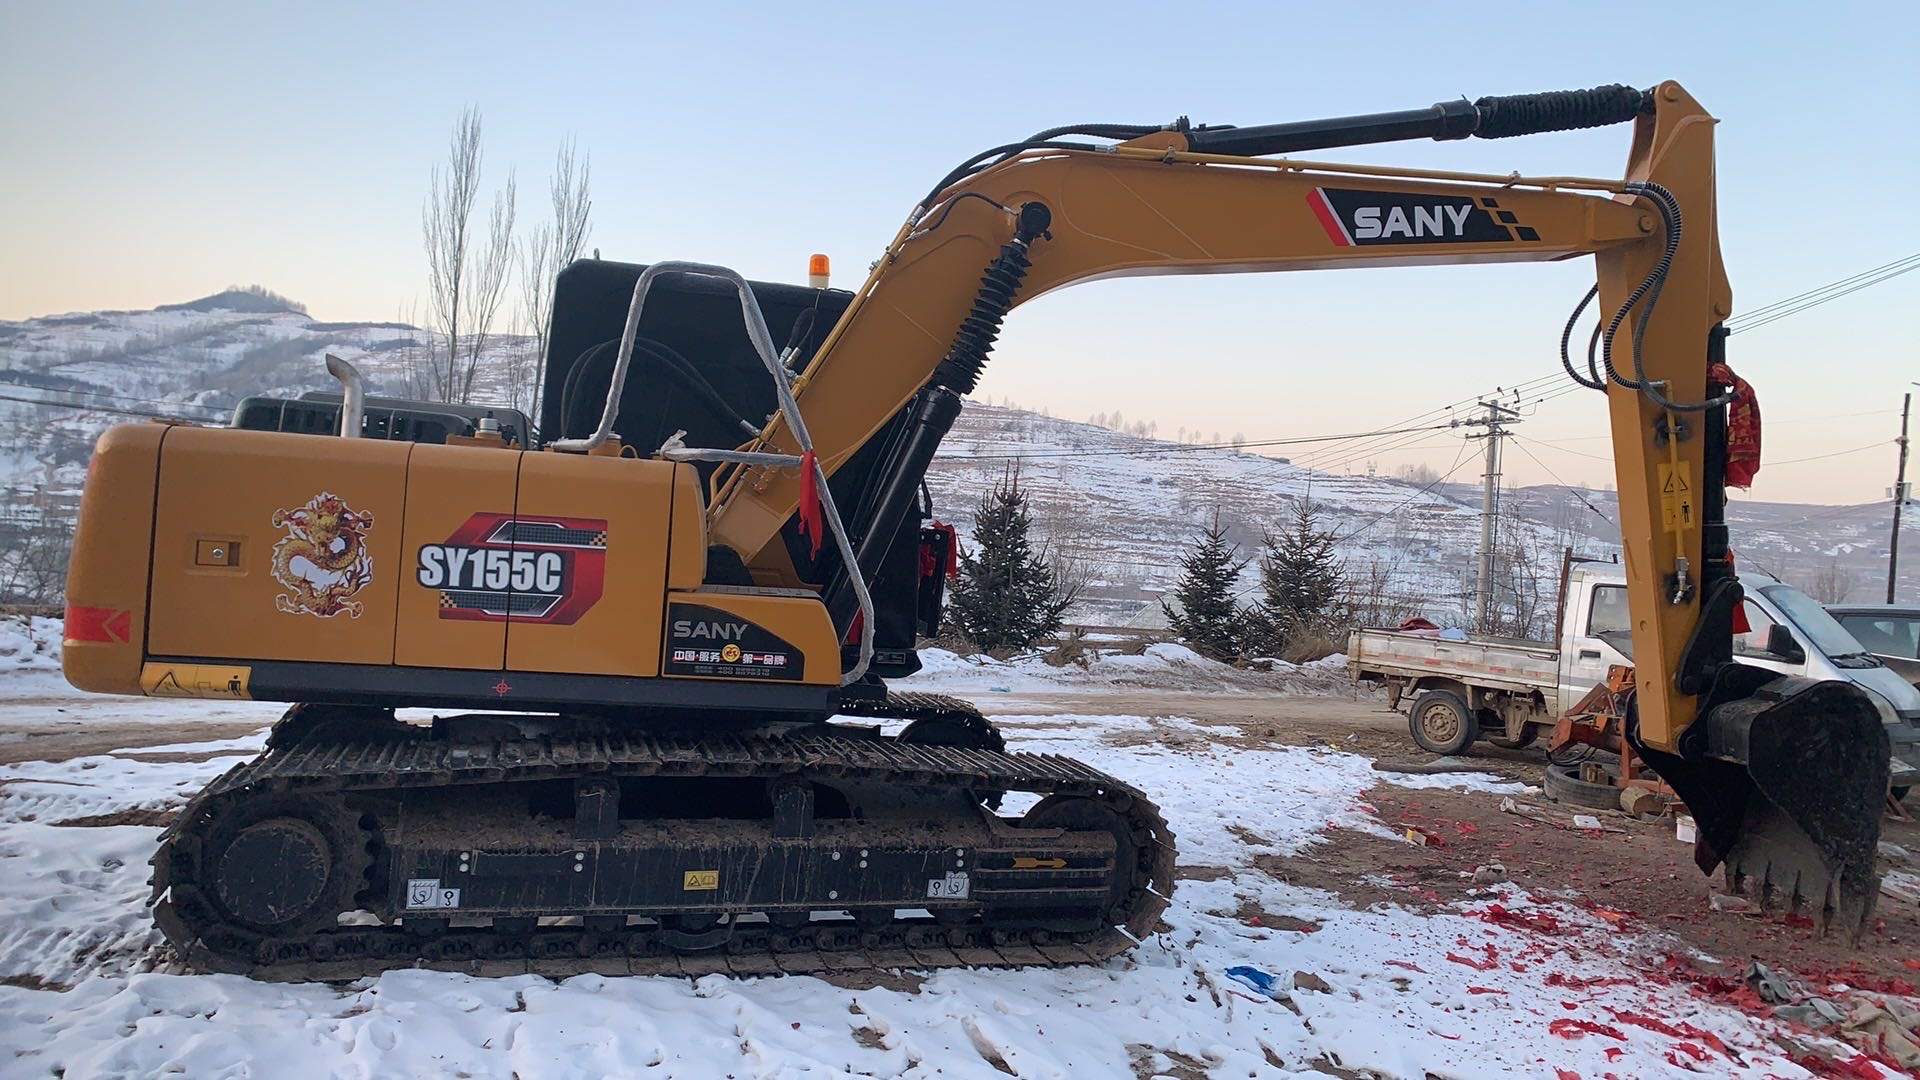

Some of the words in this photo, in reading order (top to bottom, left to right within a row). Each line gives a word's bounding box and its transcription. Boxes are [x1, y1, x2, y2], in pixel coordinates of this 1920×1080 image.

[1354, 205, 1473, 239] SANY
[419, 545, 562, 592] SY155C
[673, 620, 749, 640] SANY
[742, 653, 785, 666] 第一品牌
